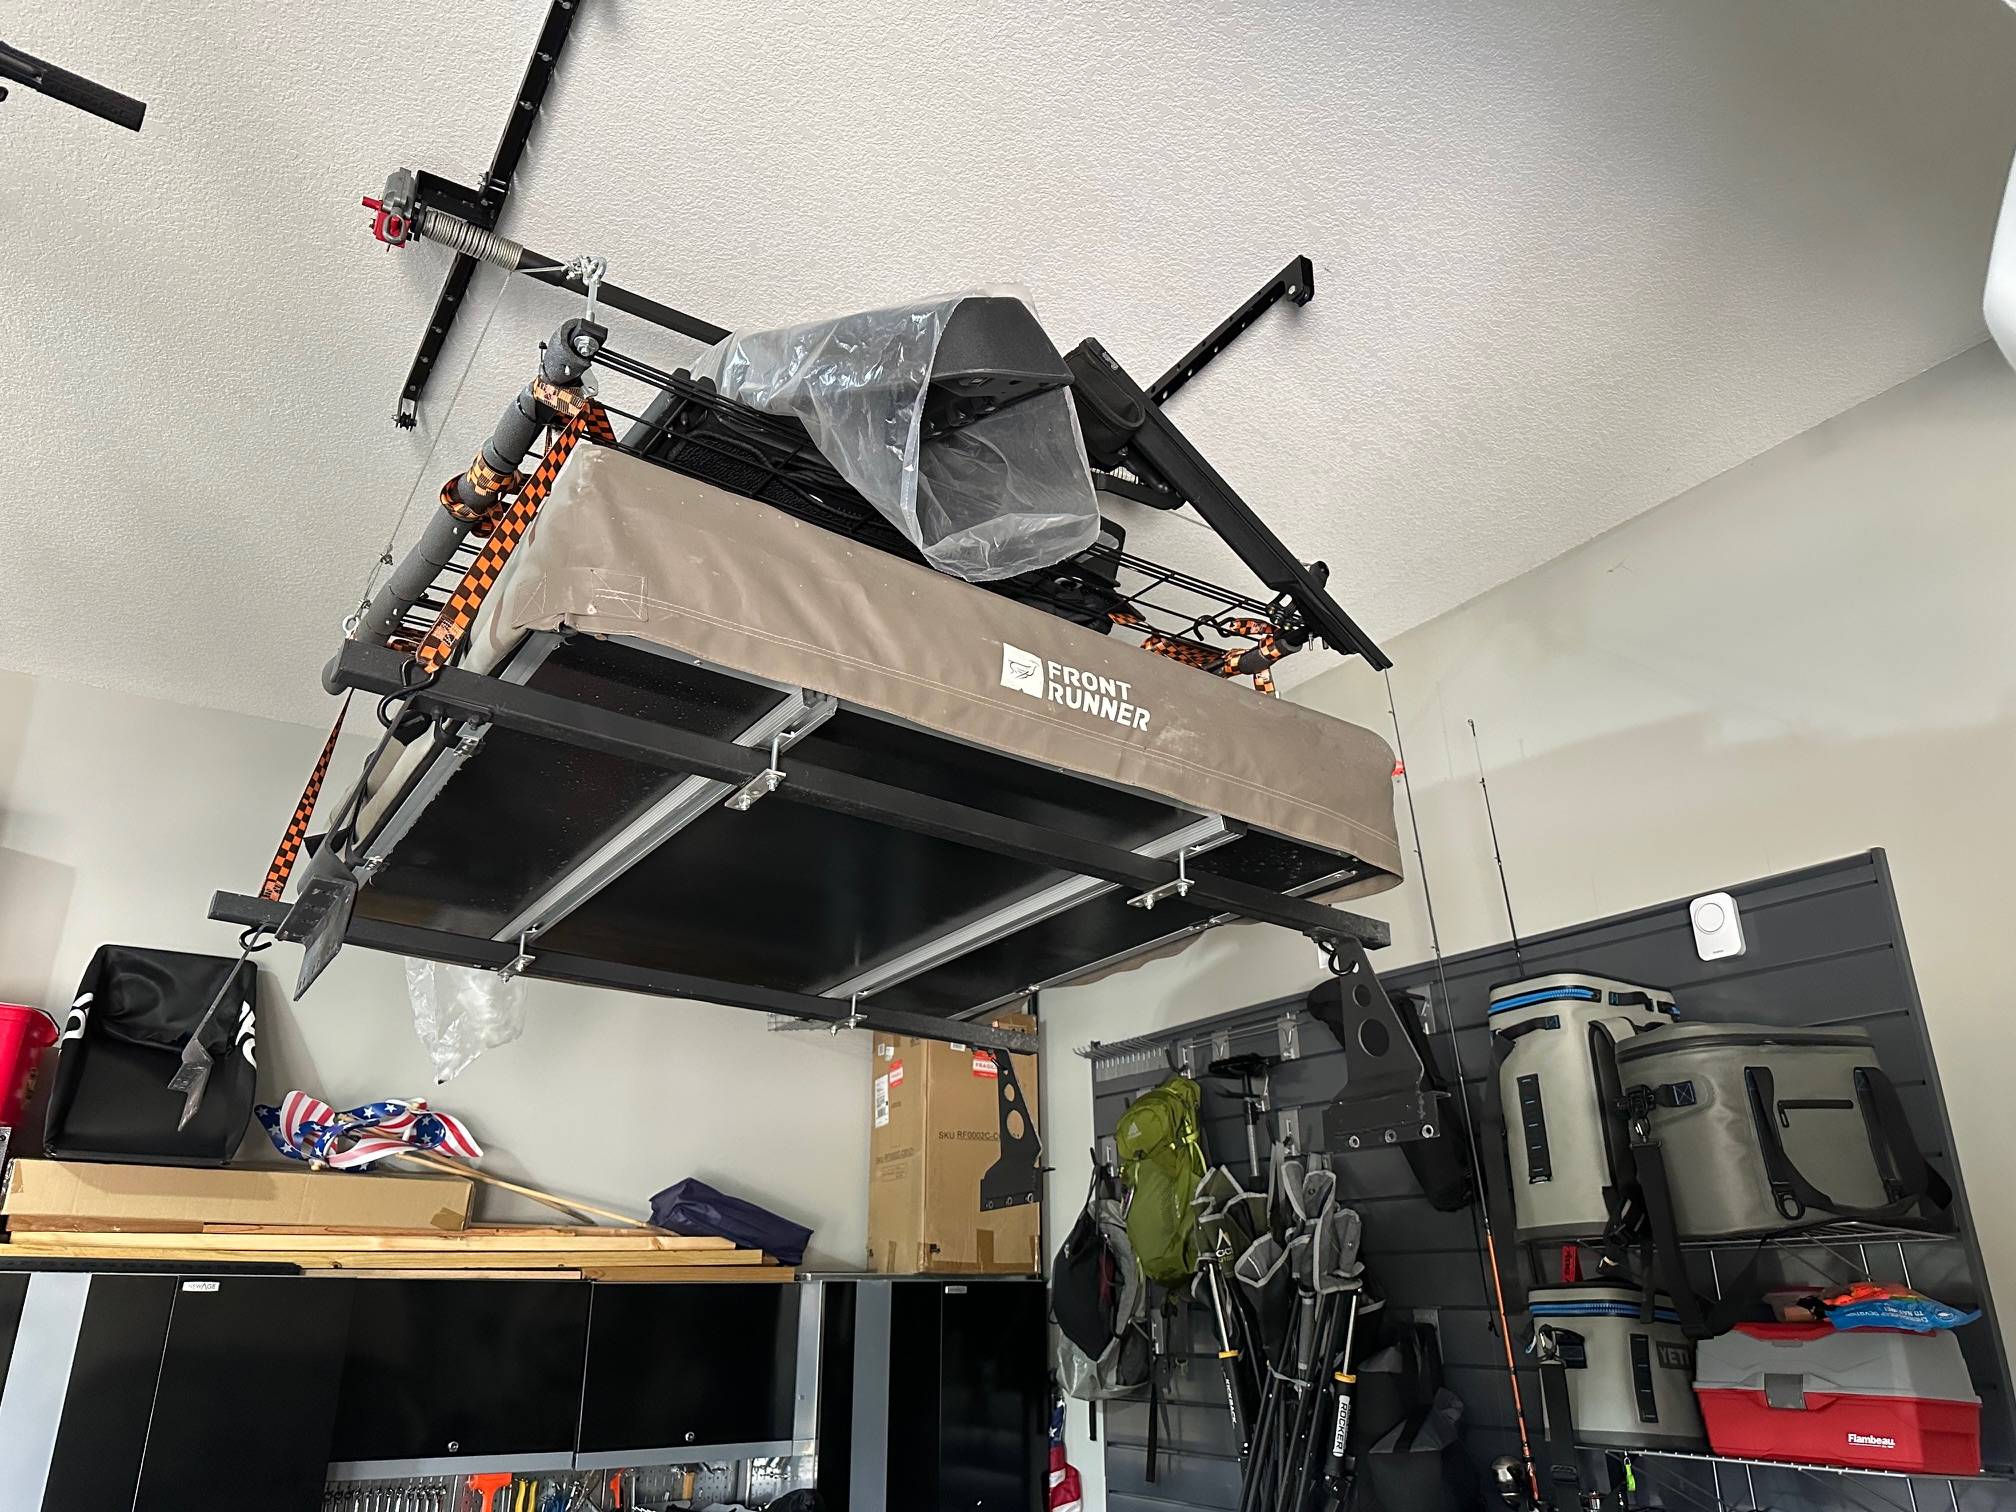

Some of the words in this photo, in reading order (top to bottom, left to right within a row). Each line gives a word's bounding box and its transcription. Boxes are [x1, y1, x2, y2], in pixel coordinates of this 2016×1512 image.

[1047, 660, 1132, 701] FRONT
[1047, 680, 1151, 732] RUNNER
[938, 1131, 955, 1140] SKU
[1657, 1344, 1690, 1366] YETI
[1225, 1378, 1237, 1424] KICKBACK
[1336, 1402, 1348, 1450] ROCKER
